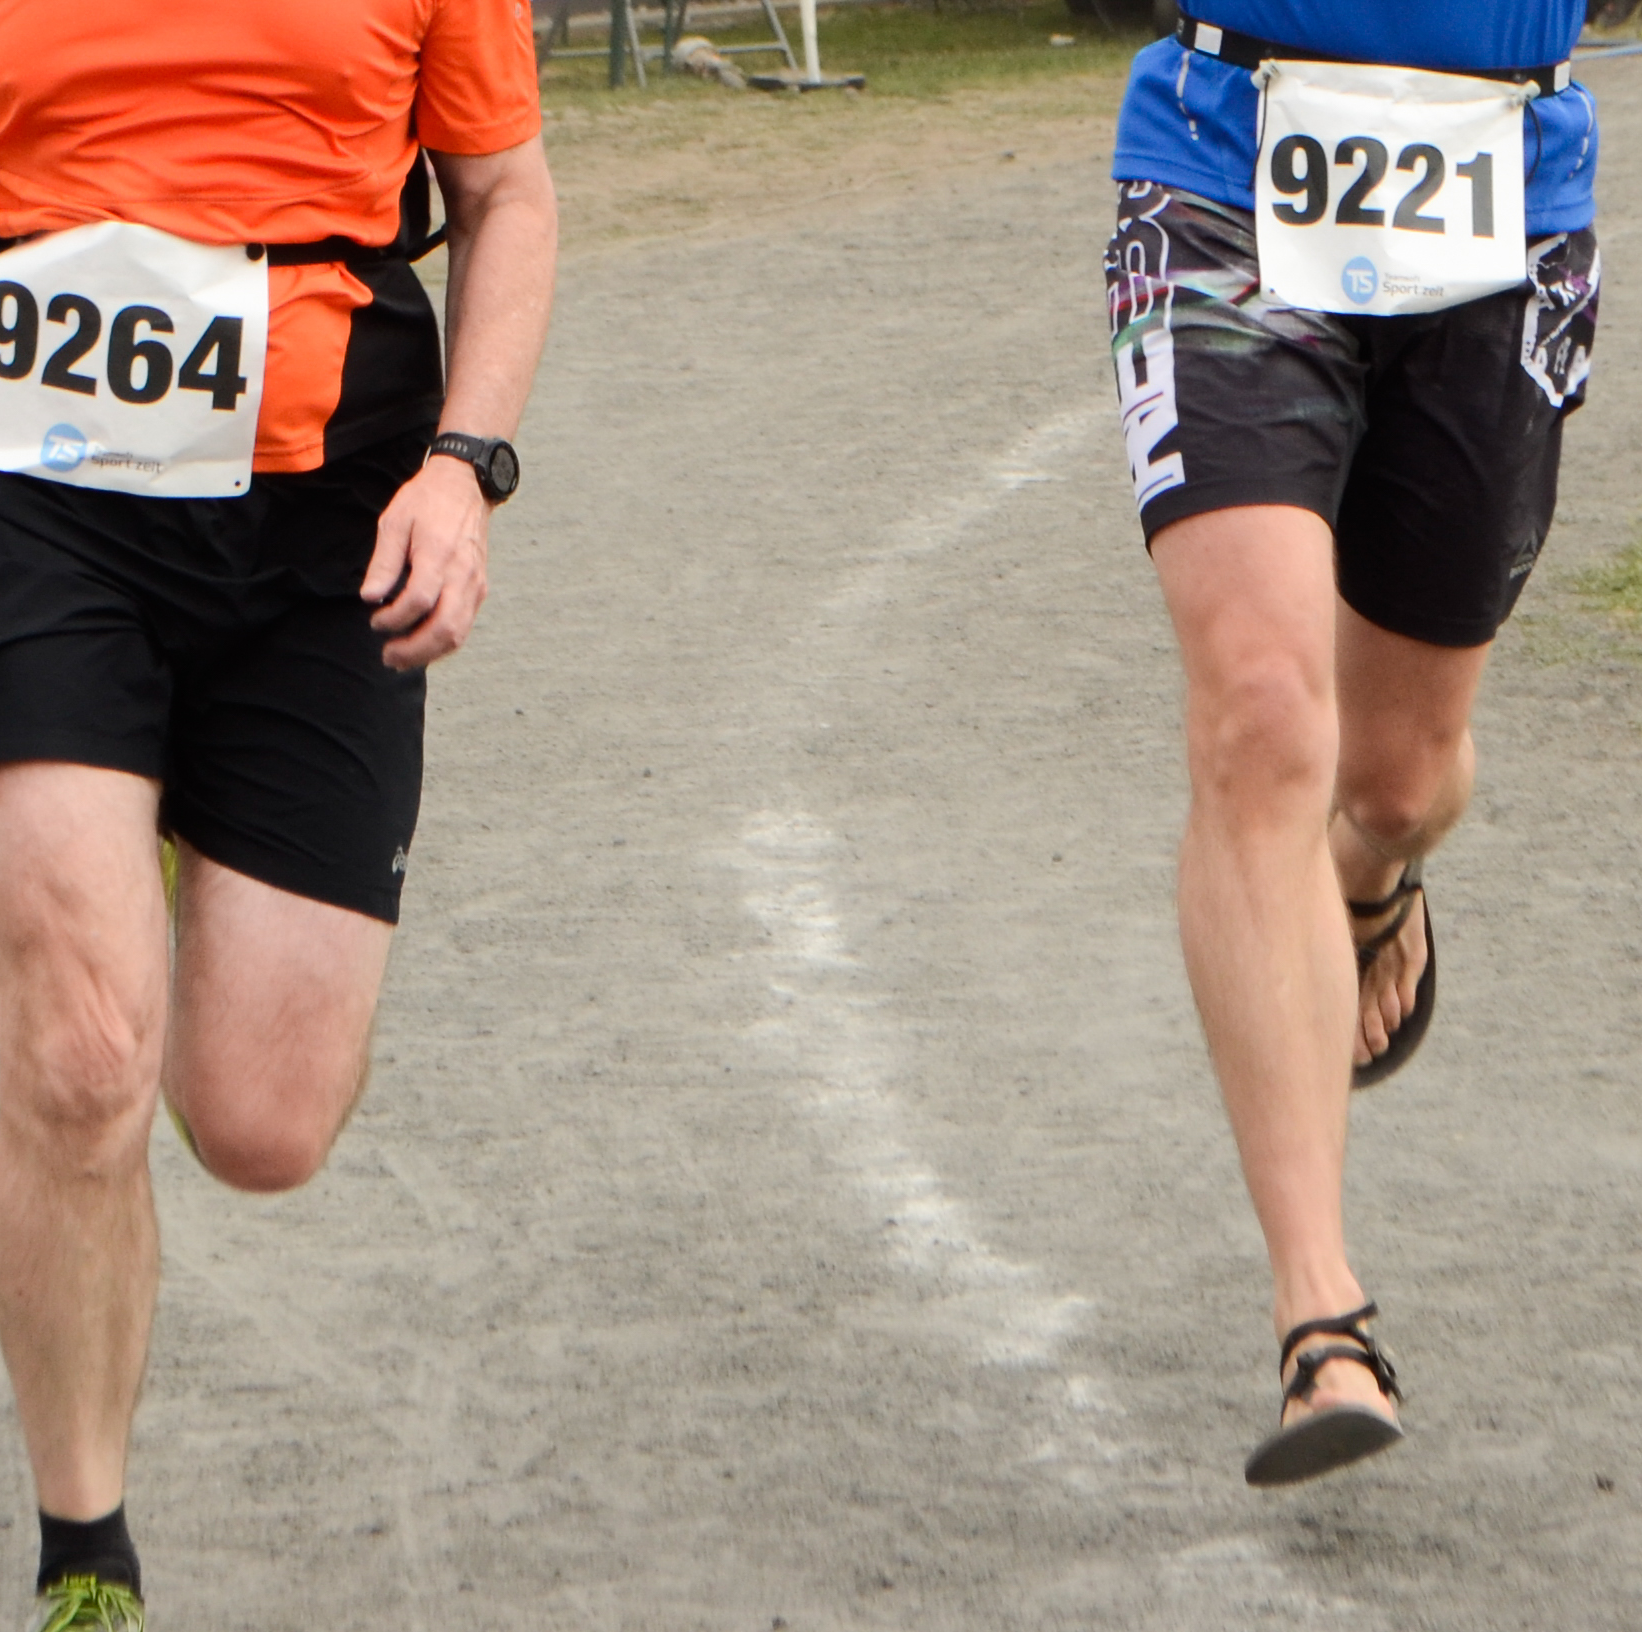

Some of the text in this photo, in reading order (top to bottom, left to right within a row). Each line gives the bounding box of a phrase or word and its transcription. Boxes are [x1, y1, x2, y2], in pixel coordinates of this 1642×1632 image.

[1269, 134, 1496, 239] 9221
[1346, 269, 1374, 294] TS
[1382, 281, 1445, 297] Sport zeit
